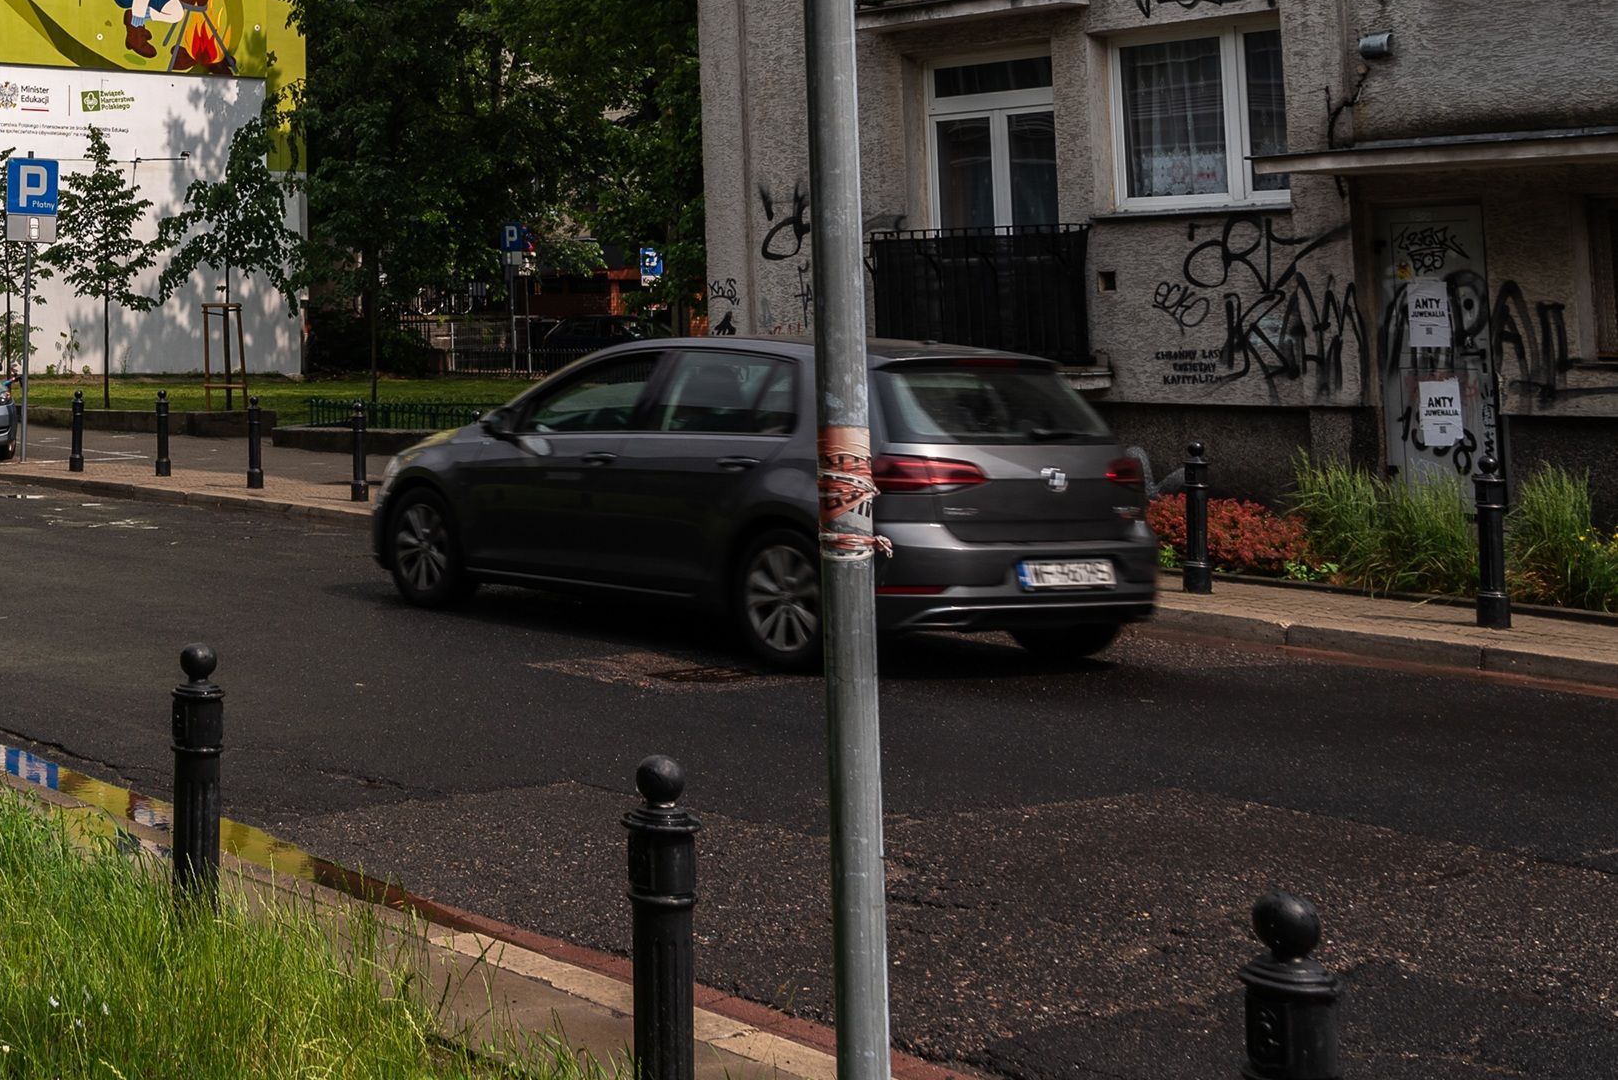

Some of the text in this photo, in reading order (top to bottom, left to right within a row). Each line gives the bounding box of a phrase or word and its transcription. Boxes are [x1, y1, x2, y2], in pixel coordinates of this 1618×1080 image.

[20, 85, 49, 94] Minister
[100, 89, 125, 98] Związek
[20, 95, 49, 105] Edukacji
[101, 103, 130, 111] Polskiego
[19, 165, 47, 207] P
[32, 200, 55, 211] Płatny
[1414, 297, 1441, 309] ANTY
[1411, 310, 1446, 318] JUWENALIA
[1202, 349, 1224, 360] LASY
[1163, 374, 1222, 385] KAPITALIZM
[1427, 396, 1454, 408] ANTY
[1424, 409, 1459, 417] JUWENALIA
